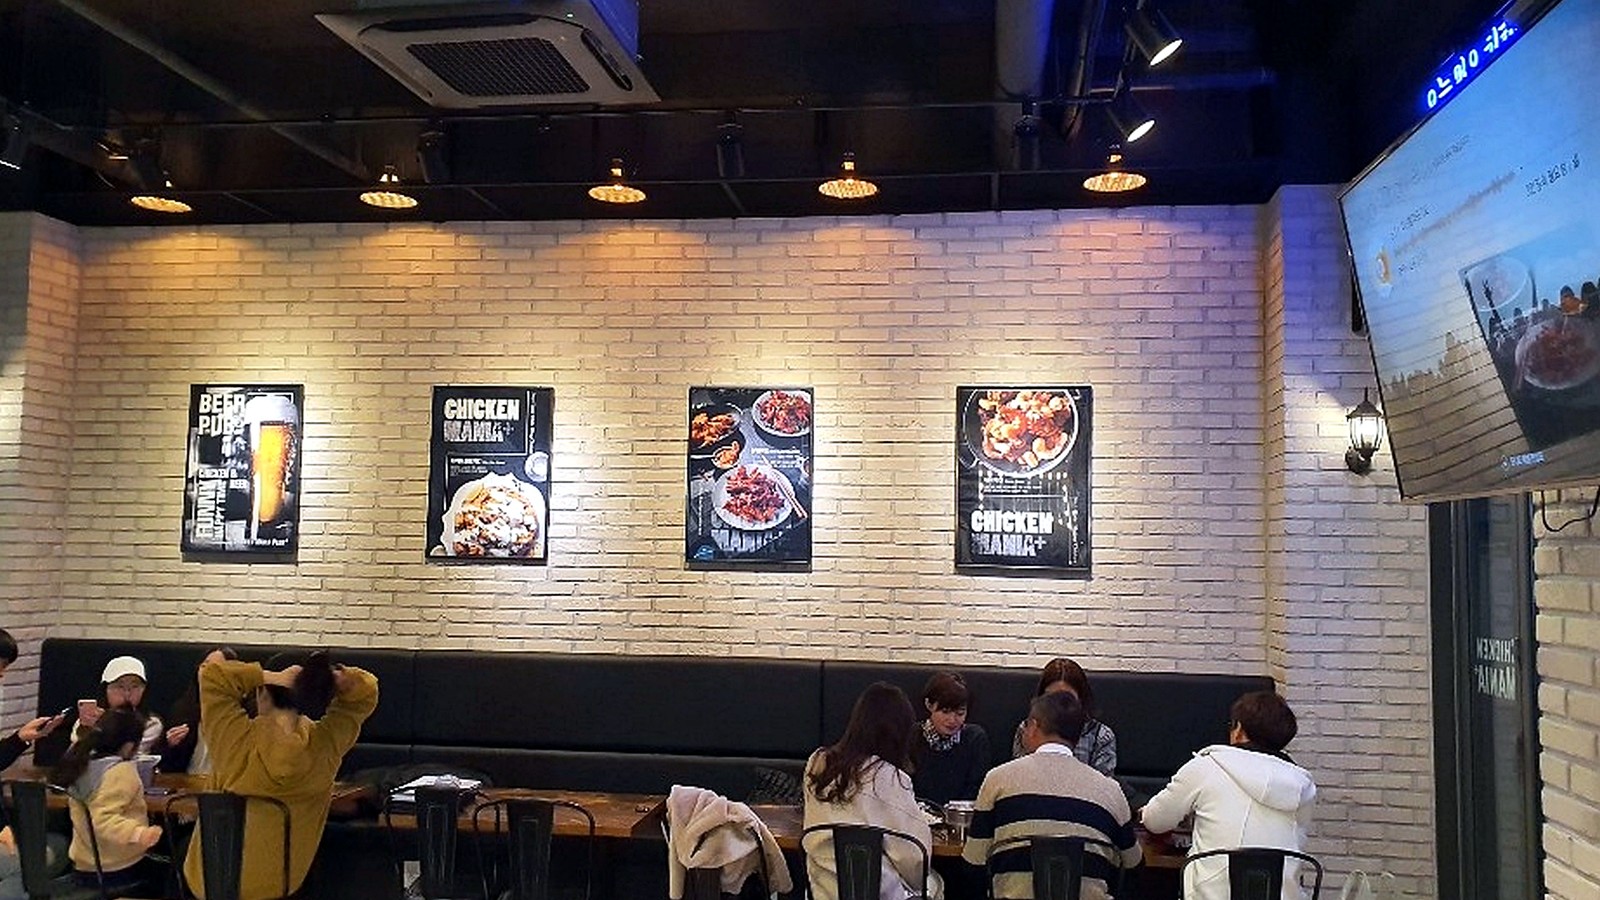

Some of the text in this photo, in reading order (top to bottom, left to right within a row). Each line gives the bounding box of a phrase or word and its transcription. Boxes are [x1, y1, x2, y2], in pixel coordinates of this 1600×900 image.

[199, 393, 246, 415] BEER
[444, 399, 520, 420] CHICKEN
[971, 510, 1054, 534] CHICKEN
